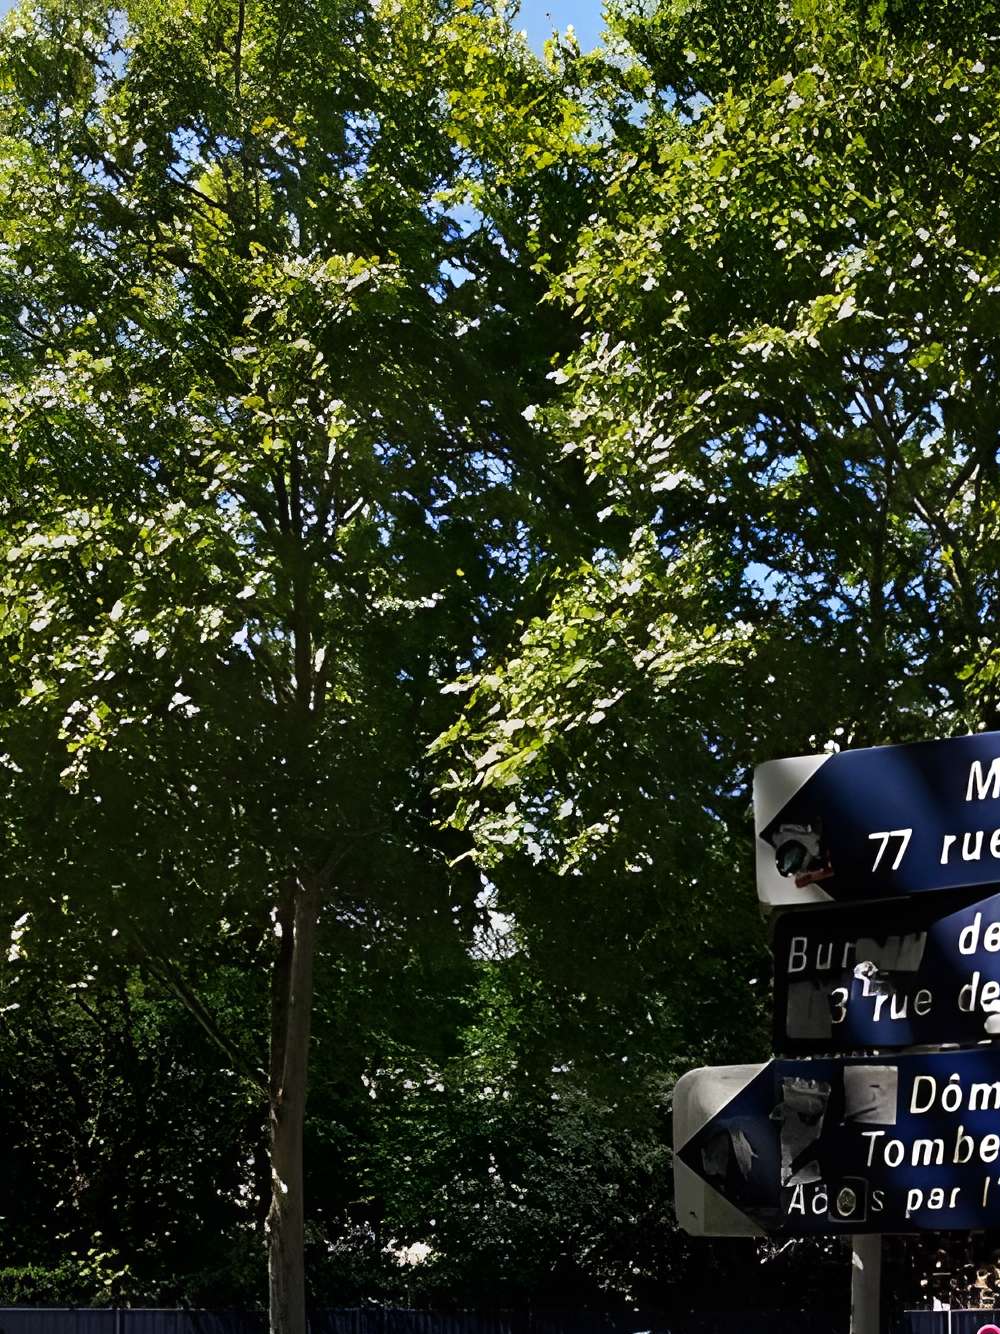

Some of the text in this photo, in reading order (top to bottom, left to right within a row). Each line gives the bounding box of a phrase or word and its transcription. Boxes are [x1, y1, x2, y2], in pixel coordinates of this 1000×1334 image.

[867, 829, 913, 873] 77
[872, 986, 933, 1023] rue
[958, 970, 1000, 1013] de
[905, 1186, 961, 1219] par
